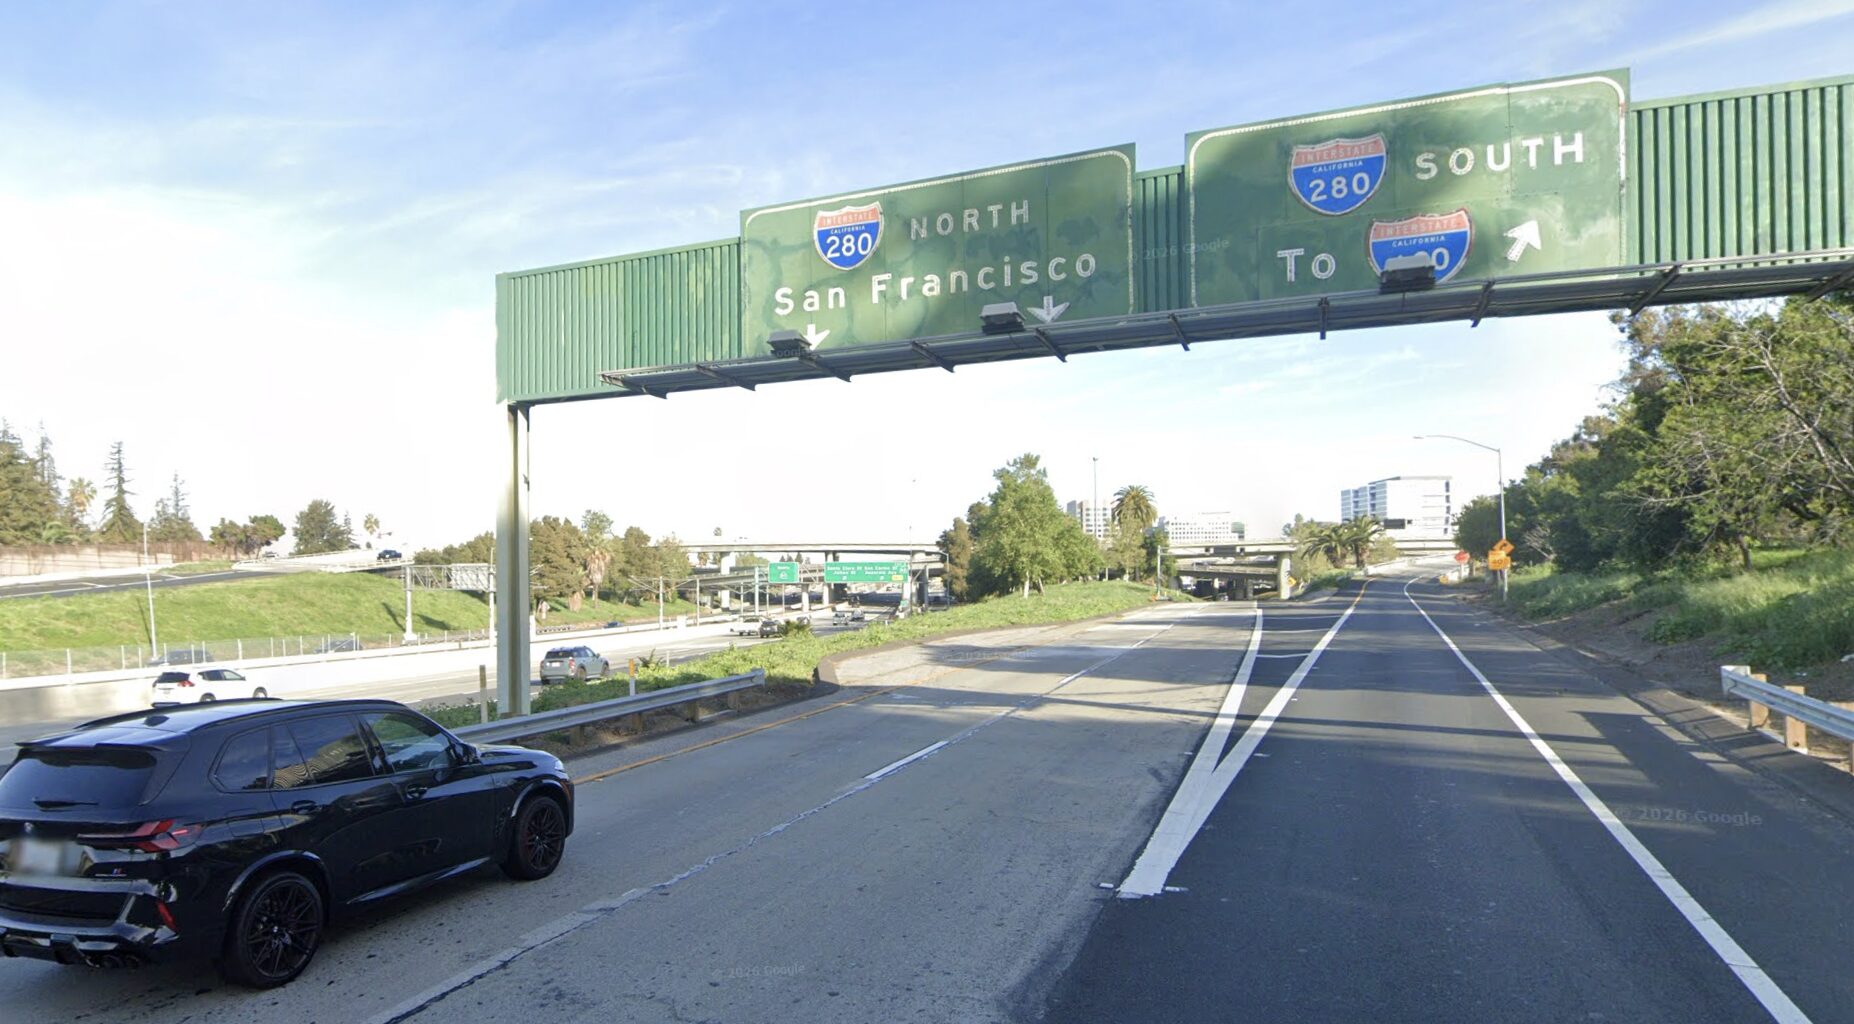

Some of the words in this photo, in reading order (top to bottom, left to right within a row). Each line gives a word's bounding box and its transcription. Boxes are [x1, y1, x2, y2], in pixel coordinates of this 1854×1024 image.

[1301, 143, 1375, 162] INTERSTATE
[1415, 132, 1585, 181] SOUTH
[1312, 160, 1364, 173] CALIFORNIA
[1308, 171, 1371, 203] 280
[823, 211, 873, 227] INTERSTATE
[830, 225, 866, 235] CALIFORNIA
[909, 200, 1030, 240] NORTH
[1380, 218, 1459, 237] INTERSTATE
[826, 232, 873, 259] 280
[1391, 235, 1446, 248] CALIFORNIA
[1276, 248, 1337, 283] To
[774, 285, 846, 316] San
[871, 253, 1096, 304] Francisco
